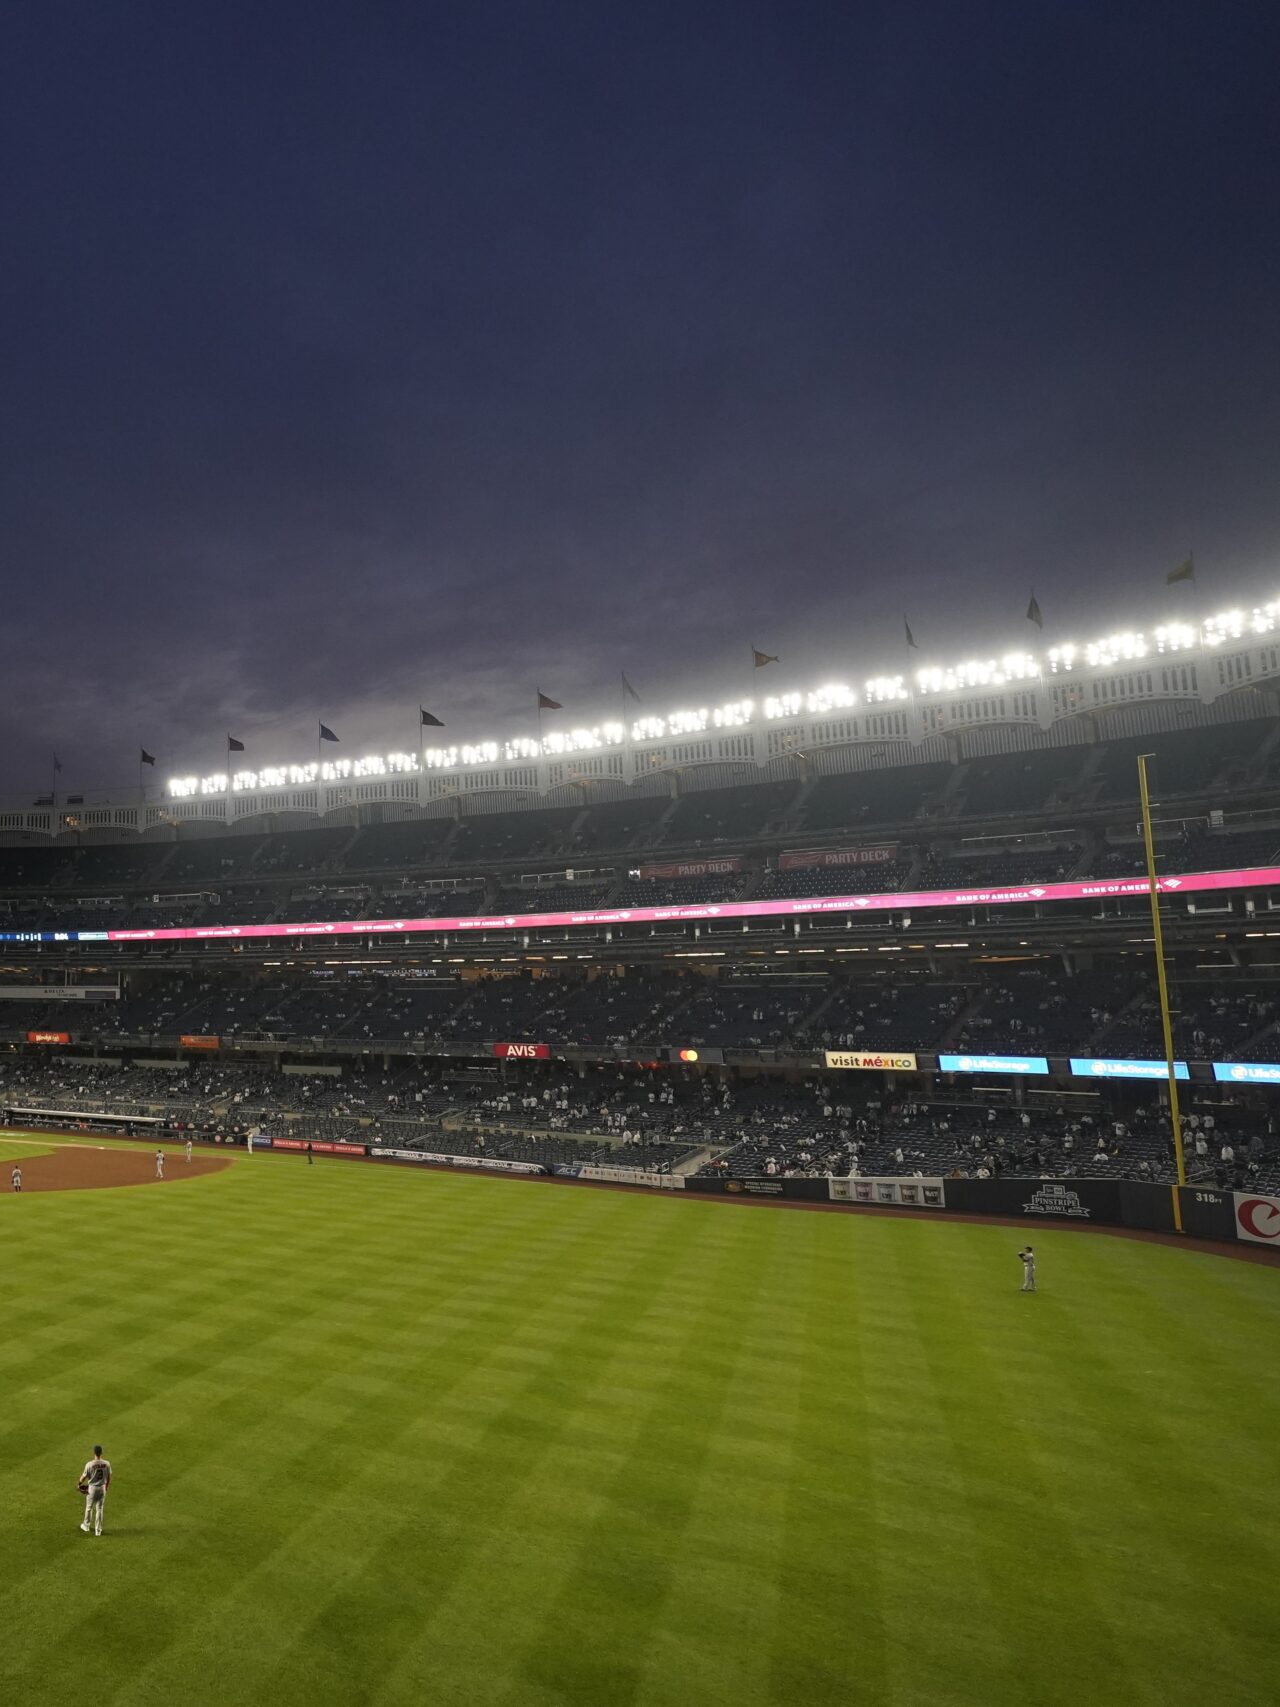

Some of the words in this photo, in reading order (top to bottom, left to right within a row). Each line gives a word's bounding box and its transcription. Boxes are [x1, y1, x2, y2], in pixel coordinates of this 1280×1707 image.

[825, 852, 858, 864] PARTY
[860, 848, 890, 862] DECK
[678, 864, 707, 876] PARTY
[708, 861, 734, 873] DECK
[1121, 882, 1164, 892] AMERIA
[991, 892, 1029, 900] AMERICA
[507, 1045, 536, 1057] AVIS
[831, 1056, 860, 1067] visit
[558, 1167, 577, 1175] ACC
[1035, 1197, 1078, 1207] PINSTRIPE
[1195, 1192, 1215, 1203] 318
